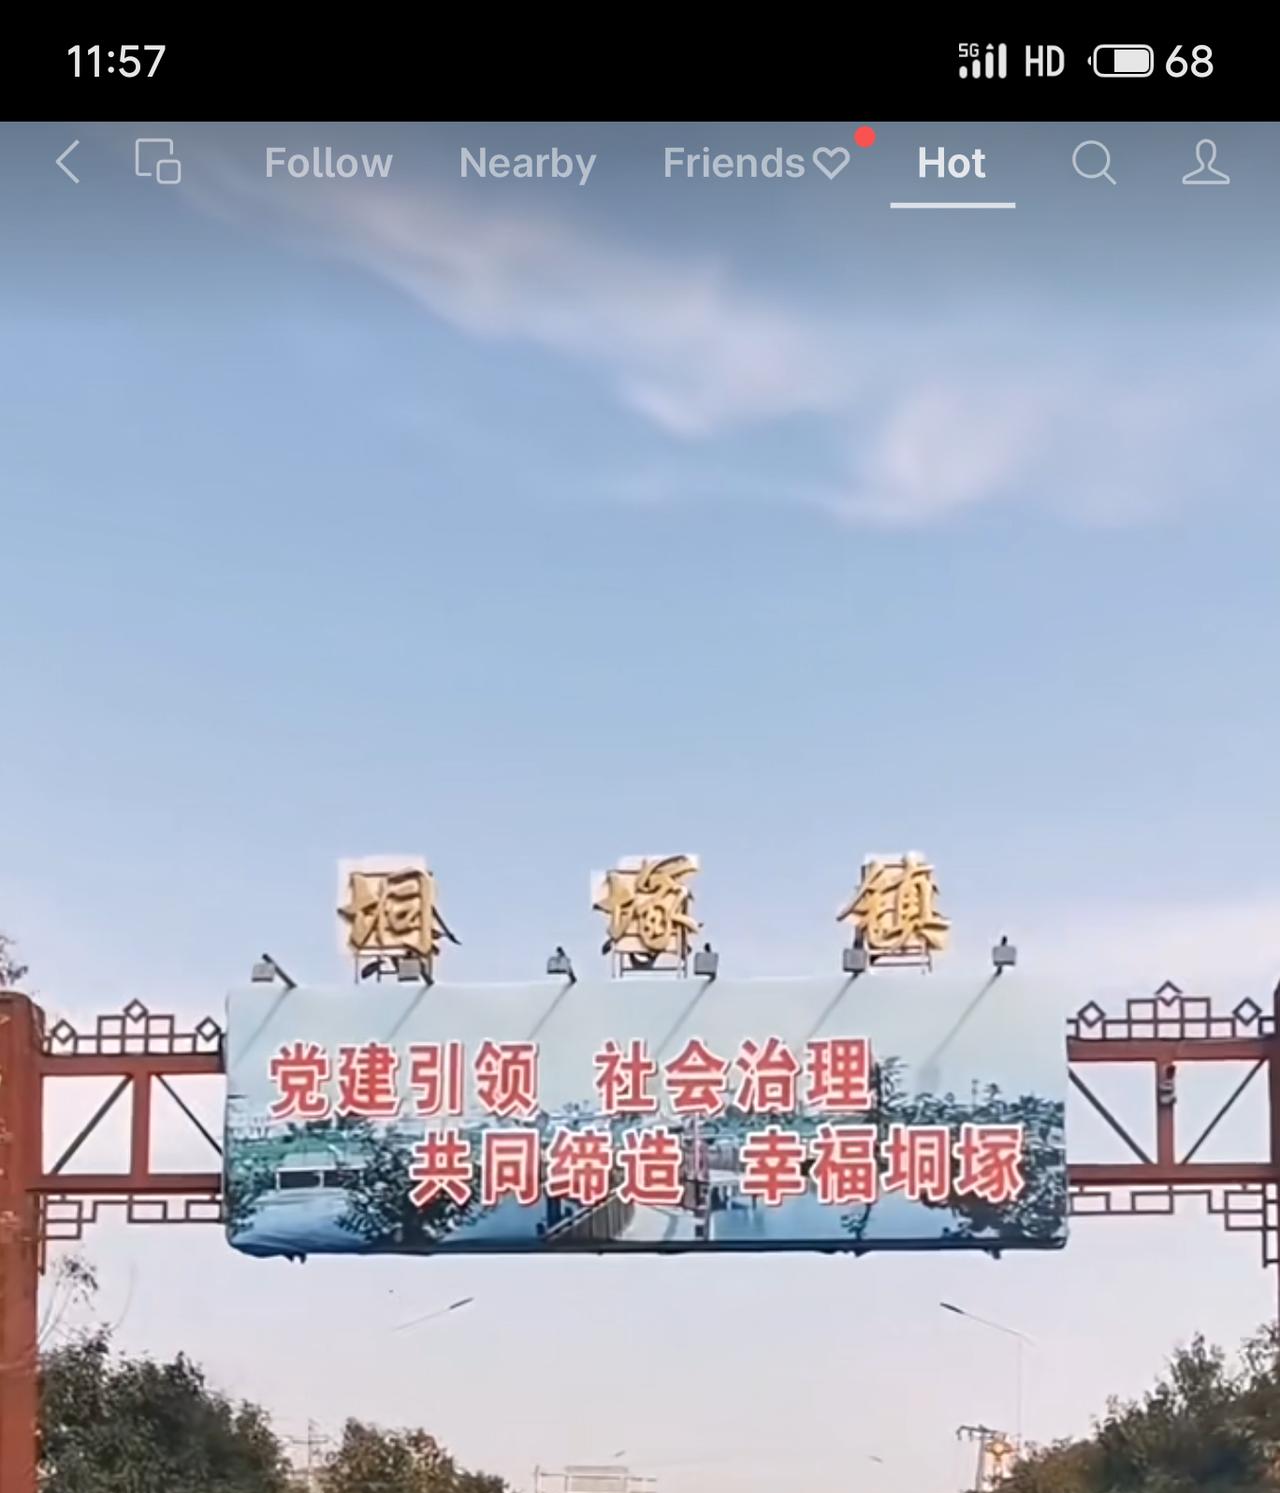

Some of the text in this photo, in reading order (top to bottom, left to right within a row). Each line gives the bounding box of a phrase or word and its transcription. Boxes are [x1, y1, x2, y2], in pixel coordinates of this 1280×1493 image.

[837, 857, 949, 951] 镇
[269, 1036, 872, 1119] 党建引领 社会治理
[409, 1124, 1025, 1206] 共同缔造 幸福垌塚
